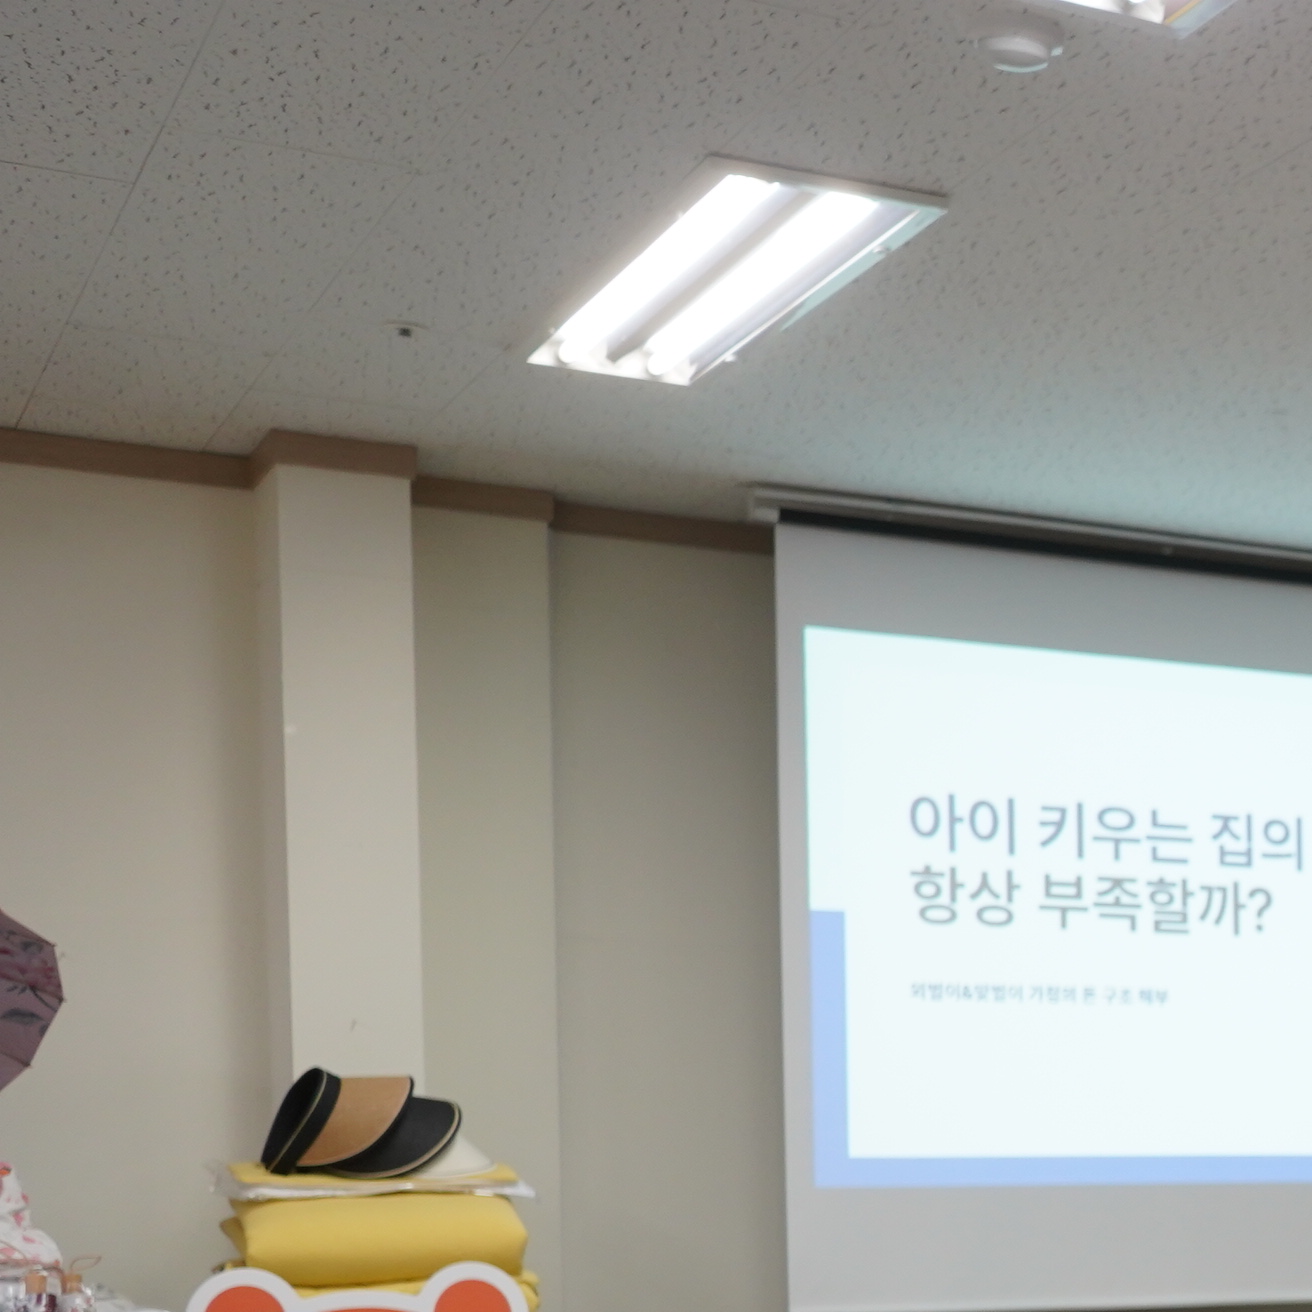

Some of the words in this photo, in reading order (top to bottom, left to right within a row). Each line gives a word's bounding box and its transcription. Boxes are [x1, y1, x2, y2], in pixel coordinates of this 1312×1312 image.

[909, 793, 1016, 856] 아이
[1039, 802, 1193, 865] 키우는
[1211, 813, 1304, 871] 집의
[909, 864, 1021, 927] 항상
[1039, 873, 1273, 936] 부족할까?
